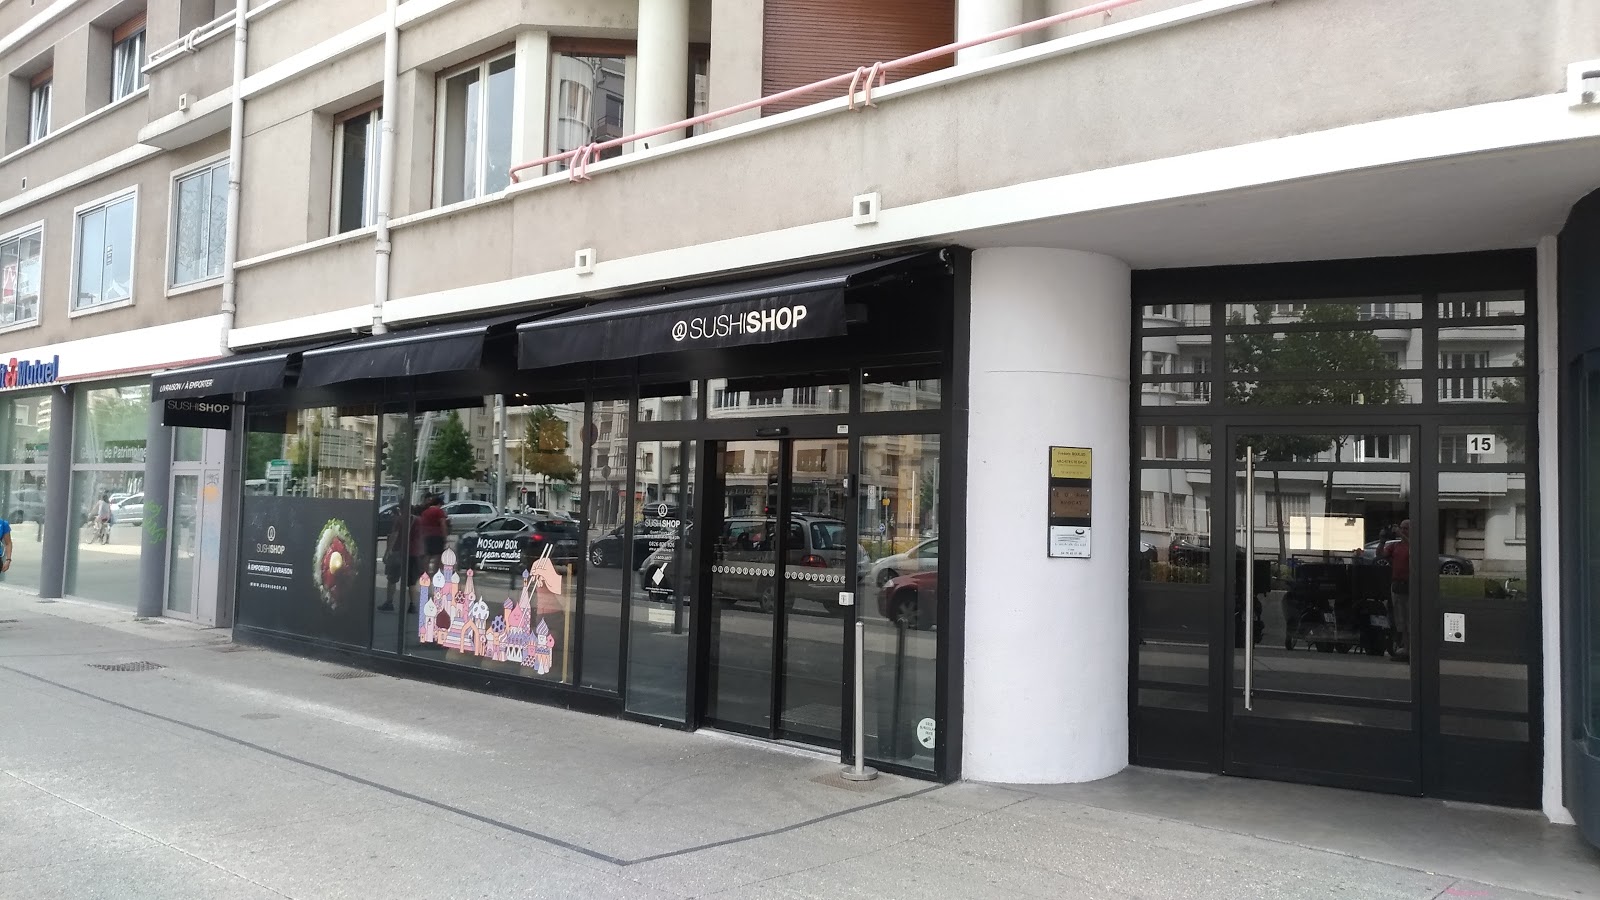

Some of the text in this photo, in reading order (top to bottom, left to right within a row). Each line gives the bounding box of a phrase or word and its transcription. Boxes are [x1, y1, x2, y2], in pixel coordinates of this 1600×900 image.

[689, 304, 807, 339] SUSHISHOP
[17, 354, 60, 386] Mutuel
[159, 382, 181, 393] LIVRAISON
[189, 379, 214, 390] EMPORTER
[167, 400, 230, 413] SUSHISHOP
[1470, 437, 1492, 451] 15
[644, 519, 681, 528] SUSHISHOP
[256, 543, 286, 555] SUSHISHOP
[476, 537, 518, 550] MOSCOW BOX
